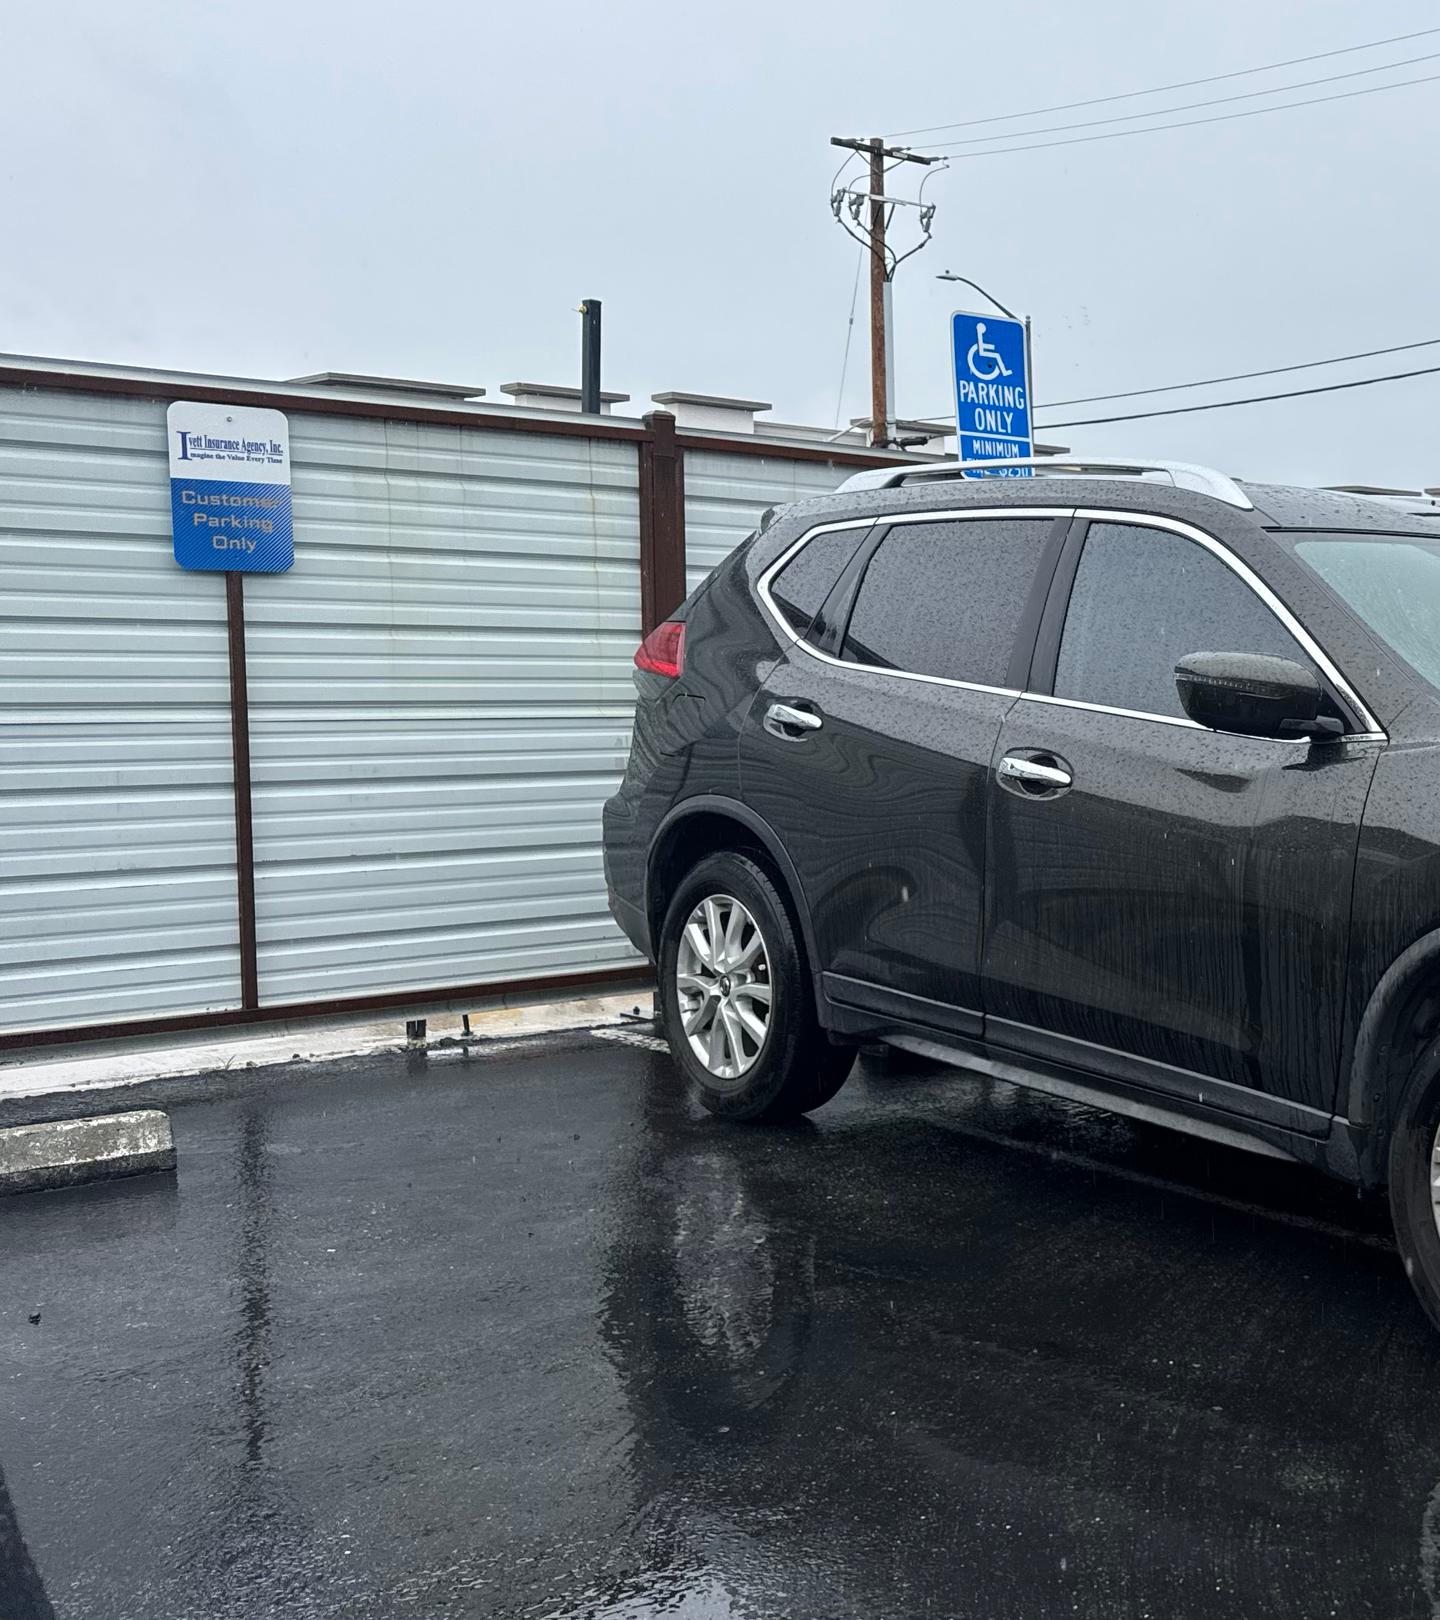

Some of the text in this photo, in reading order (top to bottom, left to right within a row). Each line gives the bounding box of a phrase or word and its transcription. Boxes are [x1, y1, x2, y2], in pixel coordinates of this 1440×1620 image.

[959, 380, 1025, 410] PARKING
[974, 407, 1014, 434] ONLY
[204, 435, 240, 450] Insurance
[241, 437, 269, 456] Agency,
[269, 439, 284, 454] Inc.
[972, 439, 1020, 459] MINIMUM
[246, 455, 265, 464] Every
[181, 490, 280, 508] Customer
[193, 512, 273, 533] Parking
[212, 535, 257, 553] Only
